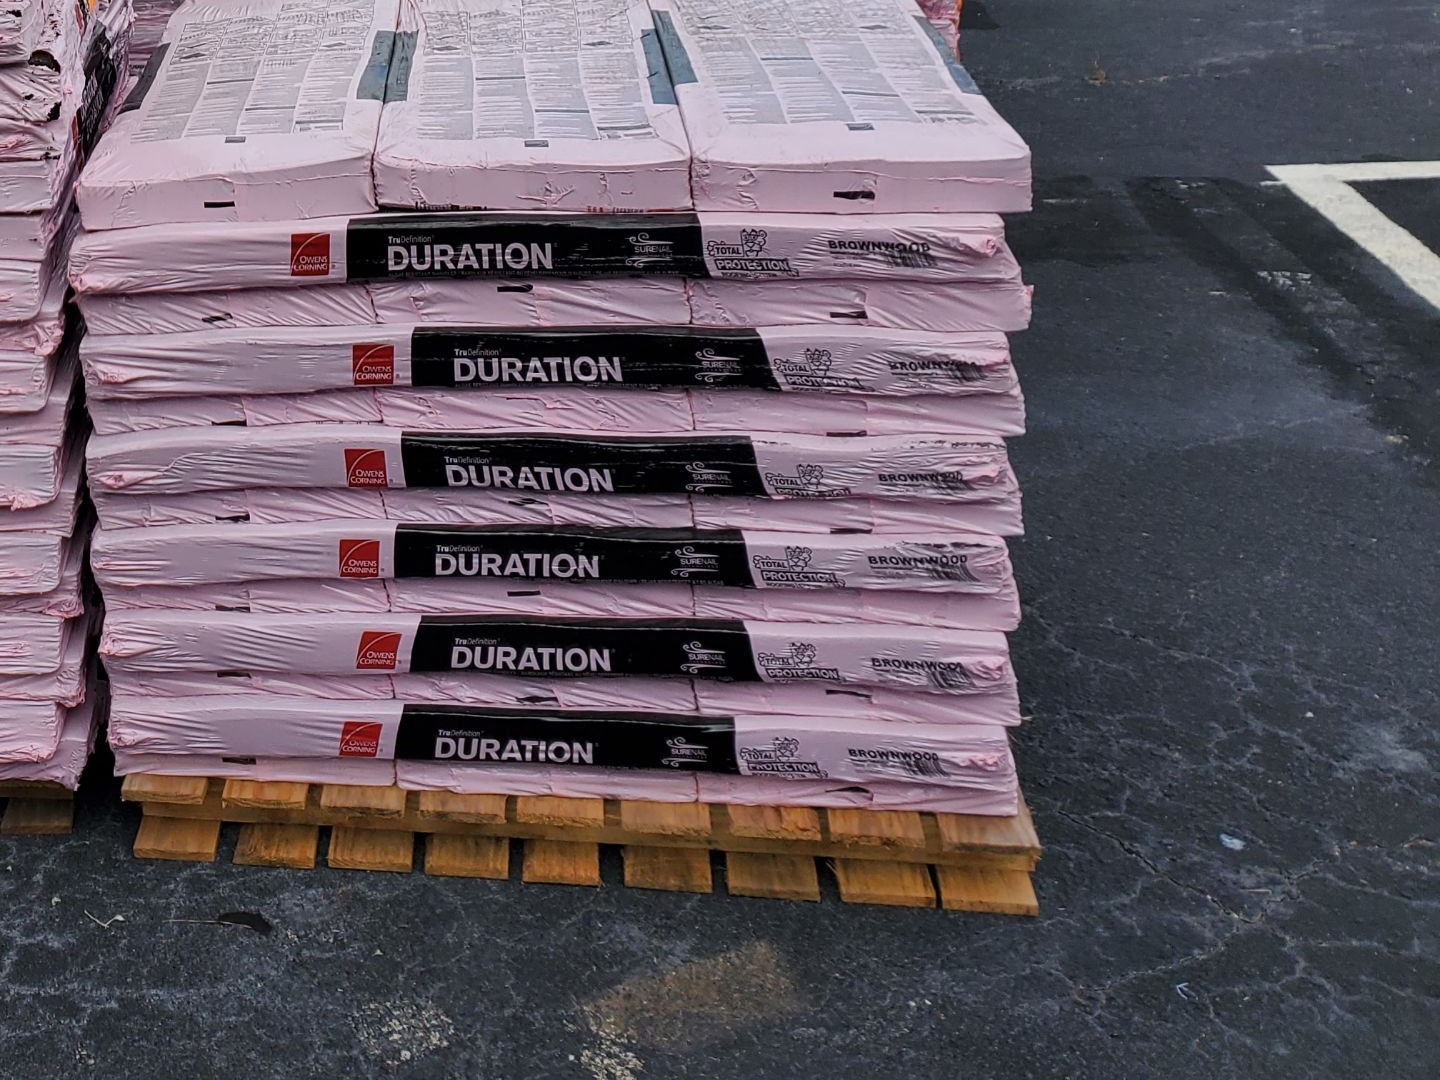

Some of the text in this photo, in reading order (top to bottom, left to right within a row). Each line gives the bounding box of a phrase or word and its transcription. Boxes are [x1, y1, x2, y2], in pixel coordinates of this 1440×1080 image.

[388, 235, 432, 244] TruDefinition
[634, 245, 672, 254] SURENAIL
[715, 246, 741, 255] TOTAL
[828, 240, 930, 253] BROWNWOOD
[300, 255, 327, 264] OWENS
[387, 242, 553, 271] DURATION
[294, 263, 328, 271] CORNING
[716, 260, 789, 271] PROTECTION
[454, 348, 499, 357] TruDefinition
[363, 365, 391, 373] OWENS
[453, 356, 624, 383] DURATION
[702, 361, 738, 369] SURENAIL
[783, 365, 809, 373] TOTAL
[356, 373, 391, 381] CORNING
[445, 455, 489, 465] TruDefinition
[356, 469, 385, 477] OWENS
[693, 473, 730, 481] SURENAIL
[350, 476, 386, 485] CORNING
[445, 464, 615, 492] DURATION
[775, 477, 800, 486] TOTAL
[436, 544, 480, 553] TruDefinition
[349, 559, 377, 567] OWENS
[680, 558, 718, 566] SURENAIL
[761, 559, 788, 569] TOTAL
[868, 554, 968, 566] BROWNWOOD
[435, 553, 599, 578] DURATION
[342, 566, 377, 575] CORNING
[762, 571, 835, 583] PROTECTION
[454, 637, 497, 646] TruDefinition
[366, 651, 395, 659] OWENS
[450, 646, 612, 672] DURATION
[689, 653, 725, 662] SURENAIL
[360, 657, 395, 665] CORNING
[871, 657, 963, 671] BROWNWOOD
[768, 668, 839, 680] PROTECTION
[438, 729, 481, 737] TruDefinition
[342, 745, 376, 753] CORNING
[434, 737, 594, 765] DURATION
[671, 748, 707, 757] SURENAIL
[747, 751, 774, 760] TOTAL
[847, 748, 939, 762] BROWNWOOD
